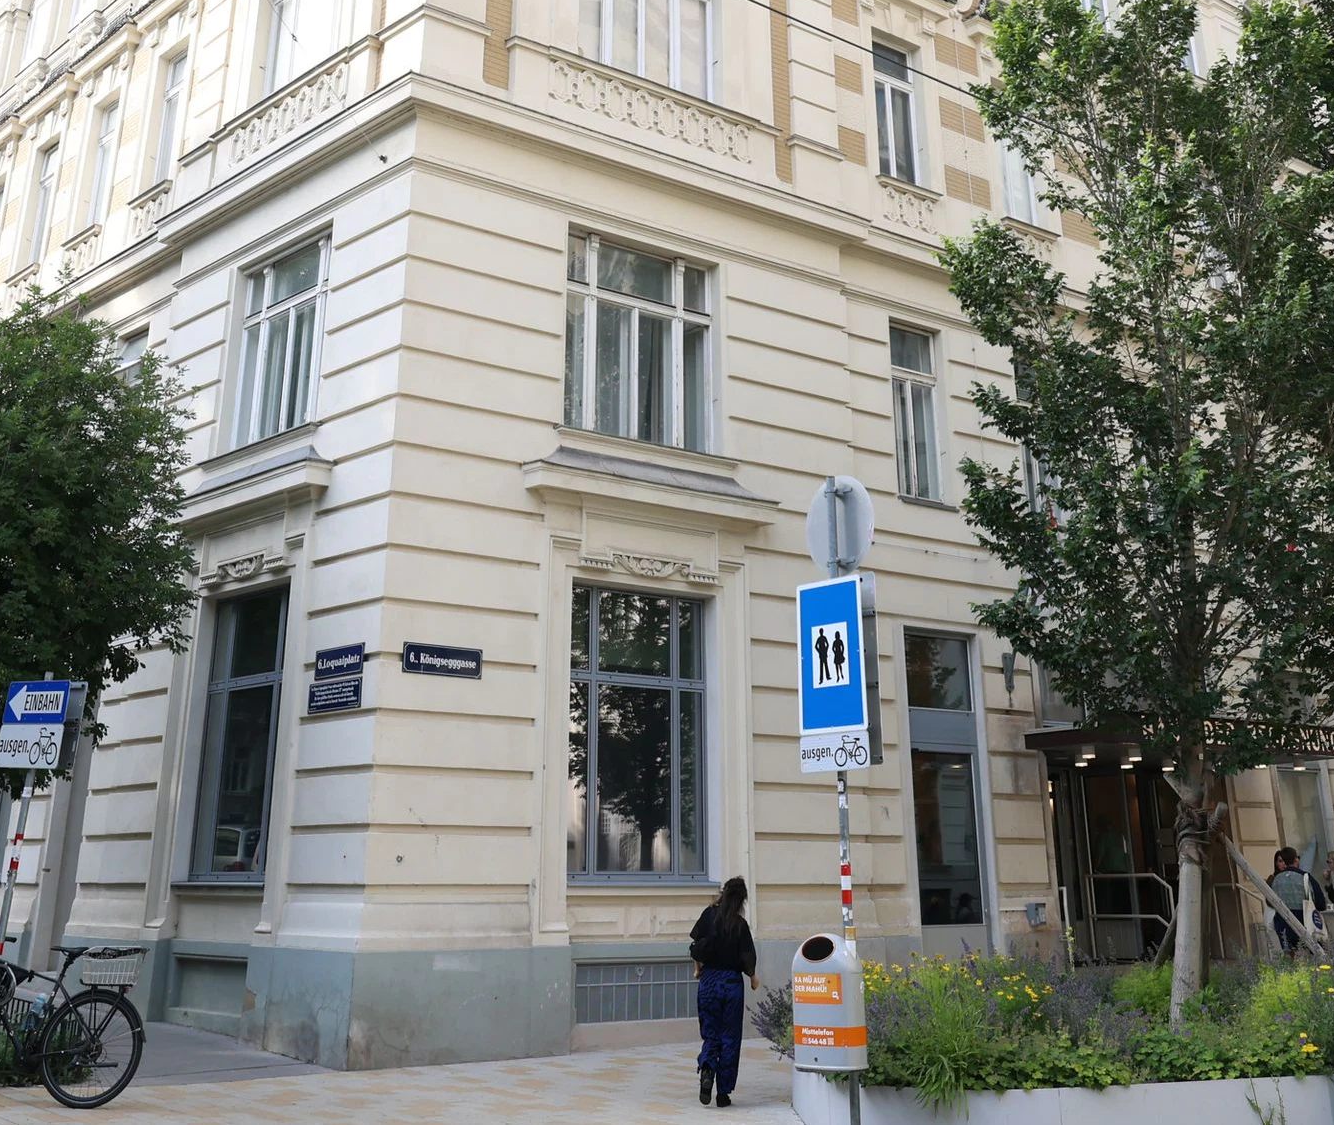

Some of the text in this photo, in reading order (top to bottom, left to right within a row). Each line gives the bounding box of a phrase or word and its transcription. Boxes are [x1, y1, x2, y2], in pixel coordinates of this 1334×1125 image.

[420, 652, 477, 670] Königsegggasse
[23, 693, 62, 711] EINBAHN
[801, 747, 834, 762] ausgen.
